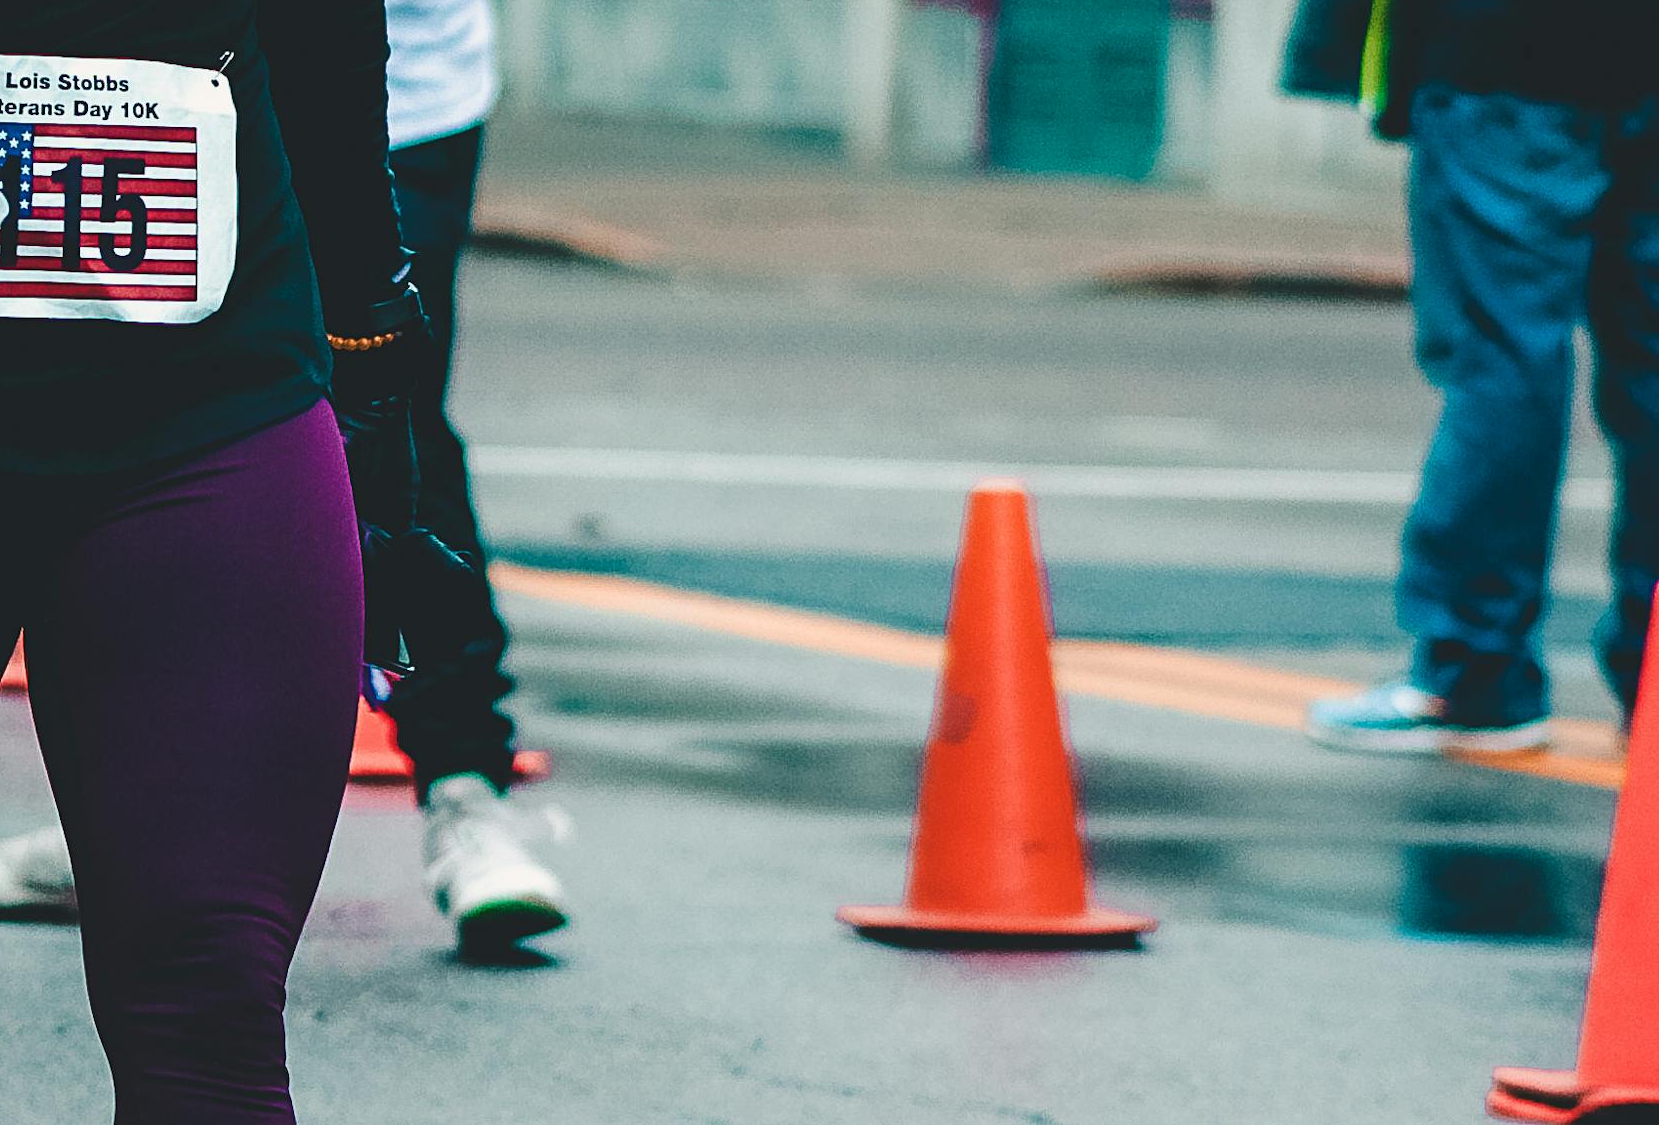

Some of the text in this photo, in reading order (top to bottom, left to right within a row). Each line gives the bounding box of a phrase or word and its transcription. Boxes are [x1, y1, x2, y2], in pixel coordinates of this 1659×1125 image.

[5, 71, 130, 92] Lois Stobbs
[73, 100, 113, 120] Day
[120, 101, 160, 120] 10K
